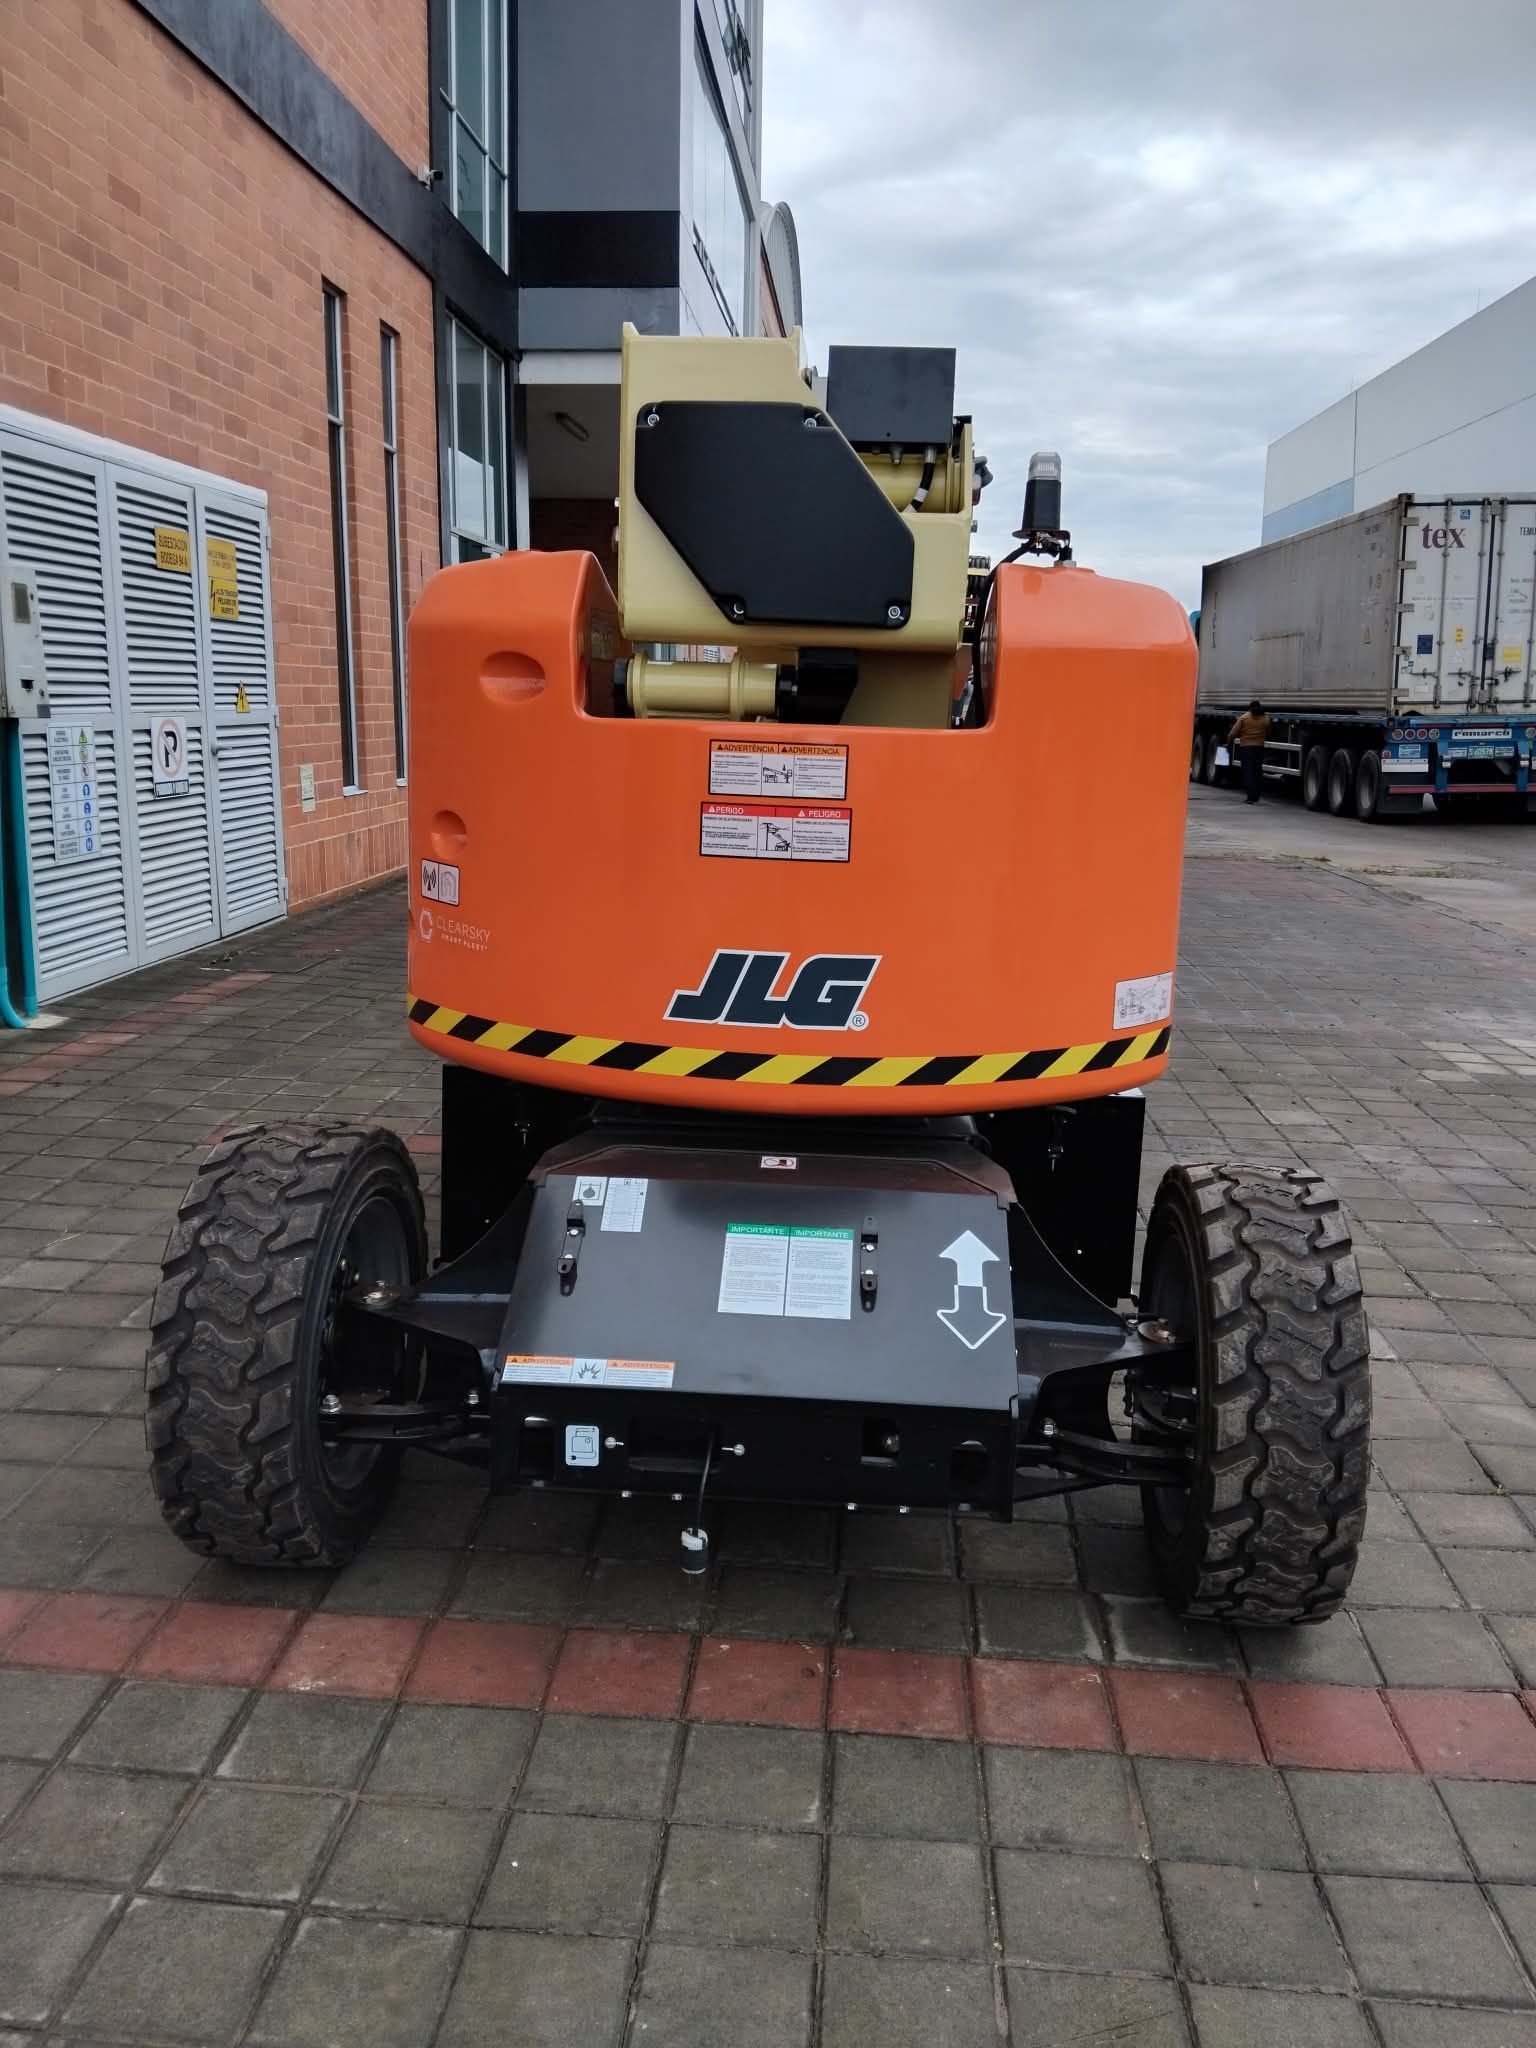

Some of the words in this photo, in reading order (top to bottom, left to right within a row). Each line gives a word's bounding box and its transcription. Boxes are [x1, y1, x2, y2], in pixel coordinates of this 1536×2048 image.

[1421, 521, 1467, 550] tex
[787, 745, 840, 756] ADVERTENCIA
[716, 806, 745, 815] PERIGO
[808, 809, 841, 819] PELIGRO
[436, 915, 492, 943] CLEARSKY
[662, 948, 884, 1031] JLG
[731, 1225, 785, 1235] IMPORTANTE
[795, 1228, 849, 1239] IMPORTANTE
